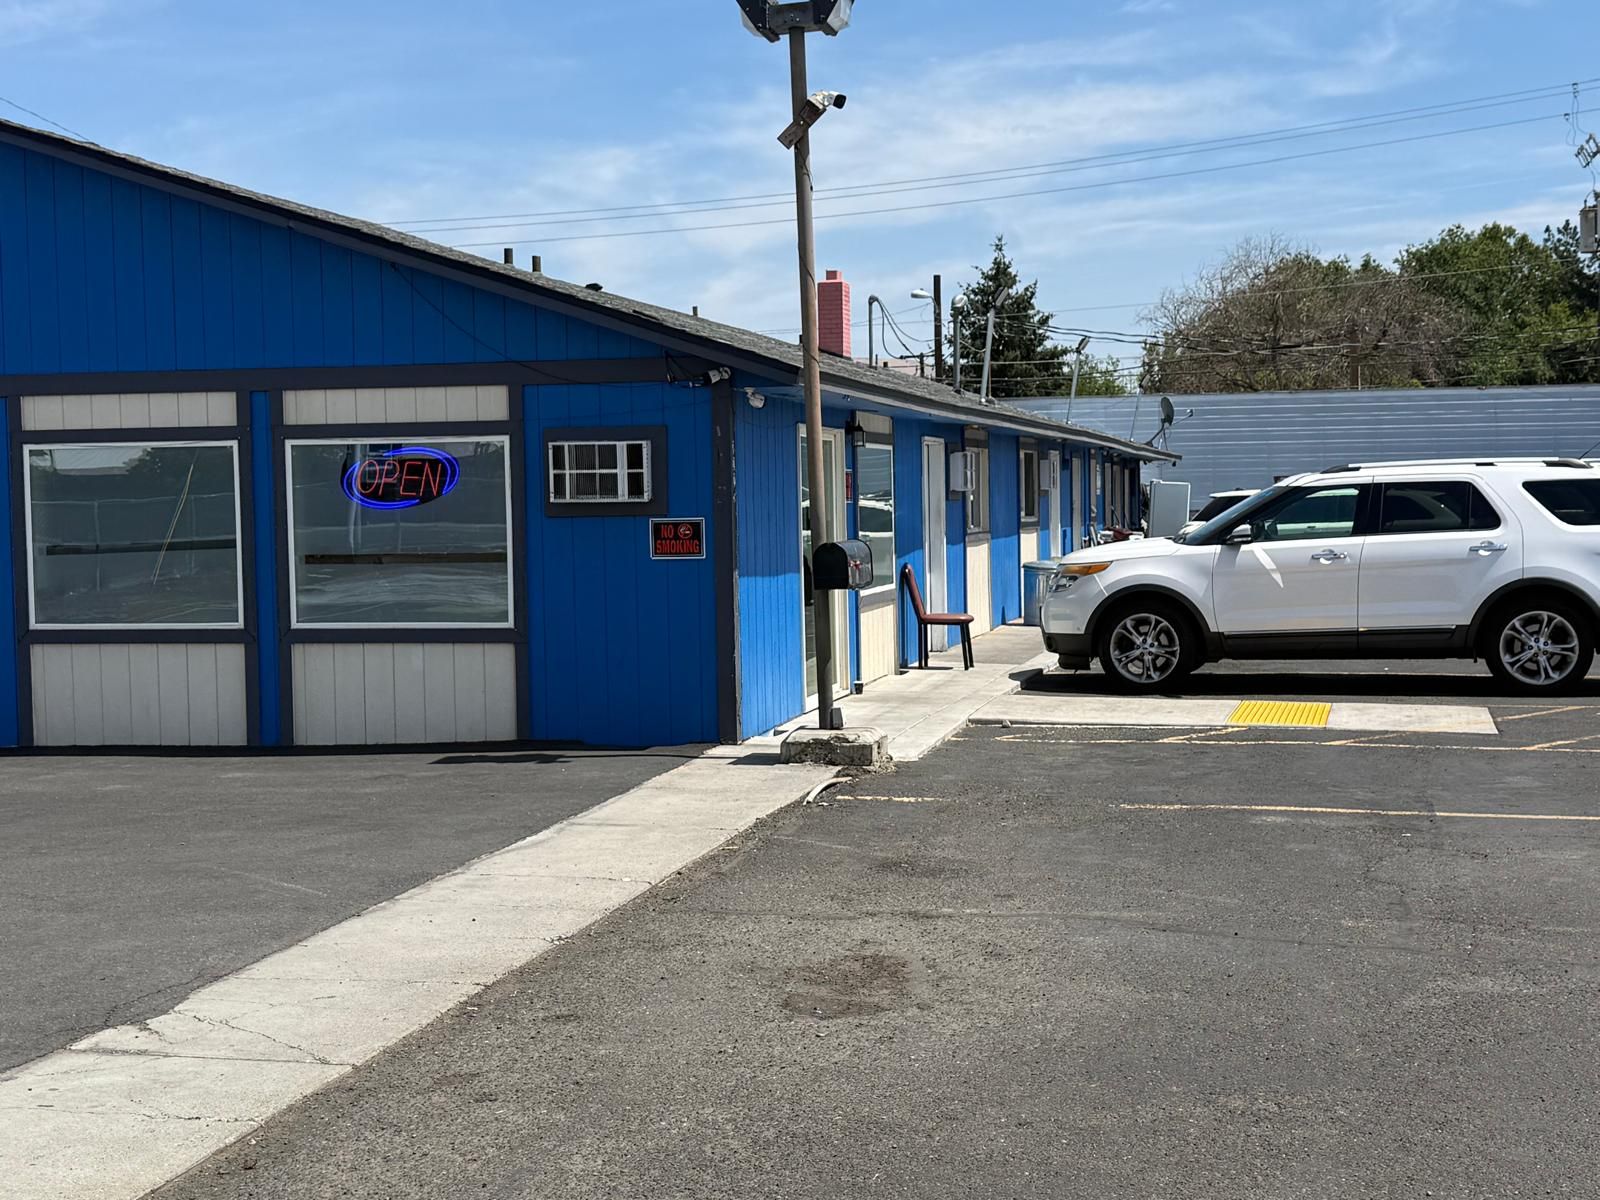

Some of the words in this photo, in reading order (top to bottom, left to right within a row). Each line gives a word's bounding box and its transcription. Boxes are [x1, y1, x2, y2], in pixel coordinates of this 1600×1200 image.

[357, 459, 442, 497] OPEN
[661, 524, 674, 538] NO
[656, 540, 700, 553] SMOKING
